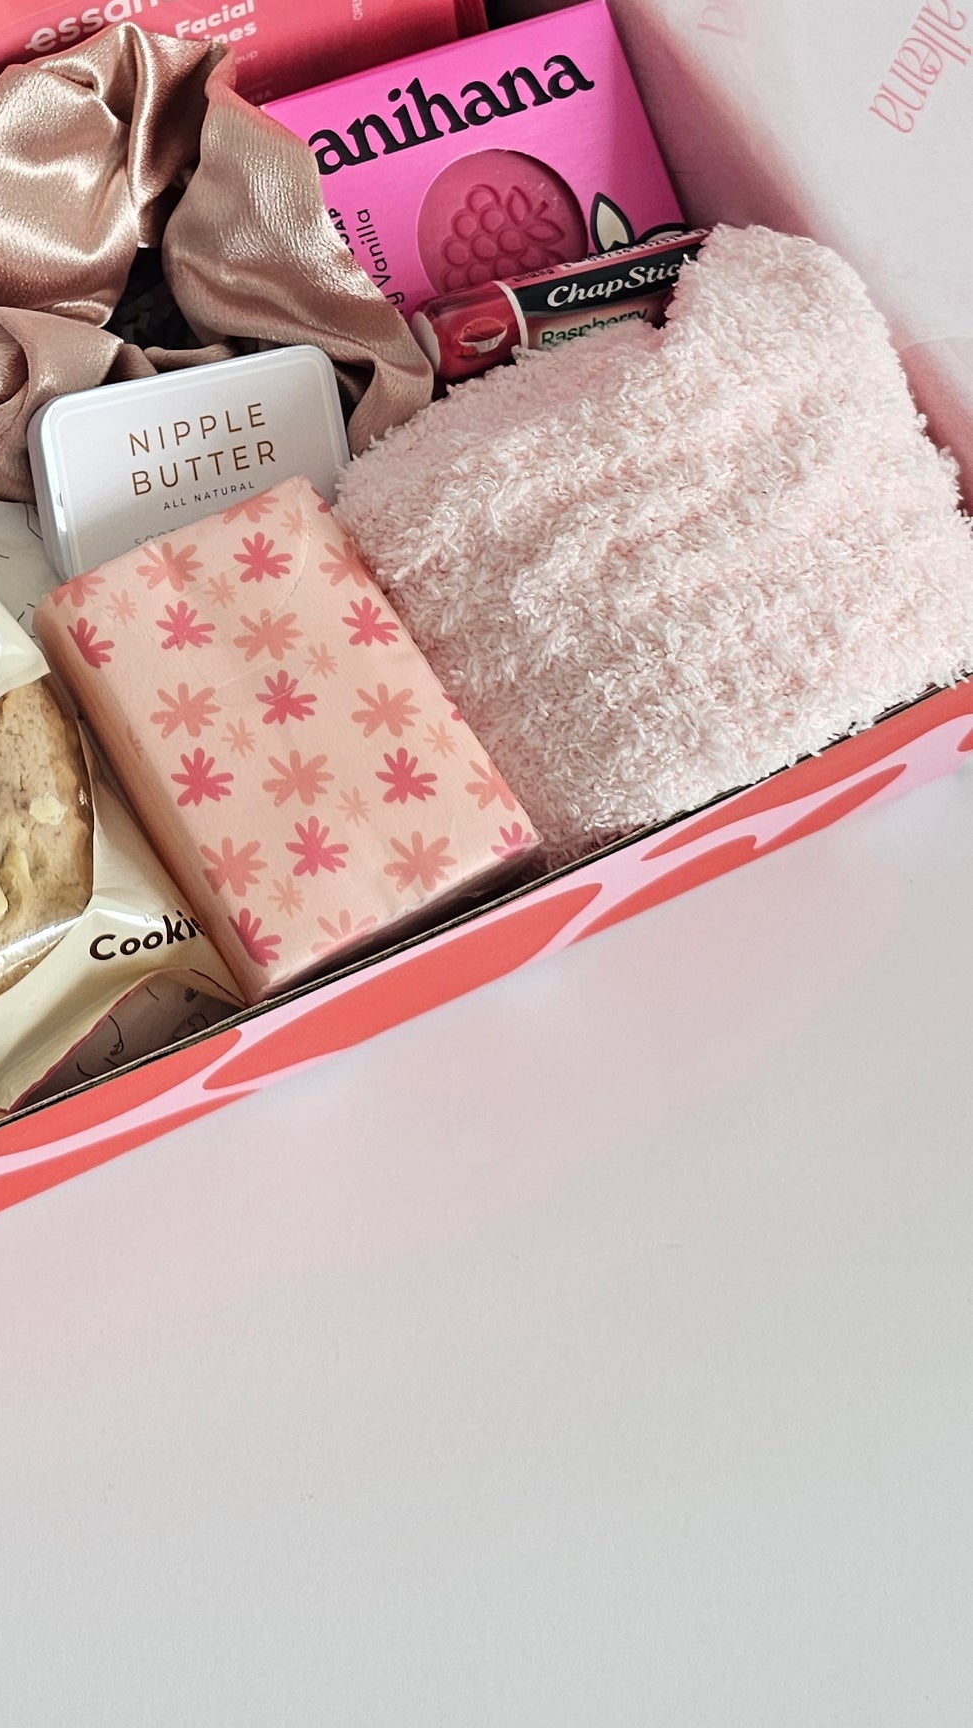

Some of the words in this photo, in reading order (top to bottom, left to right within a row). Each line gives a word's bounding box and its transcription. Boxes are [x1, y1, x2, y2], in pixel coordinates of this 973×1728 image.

[327, 207, 355, 255] OAP
[356, 208, 392, 289] Vanilla
[547, 257, 685, 308] ChapStic
[128, 401, 266, 457] NIPPLE
[131, 440, 276, 497] BUTTER
[163, 495, 188, 511] ALL
[194, 480, 256, 503] NATURAL
